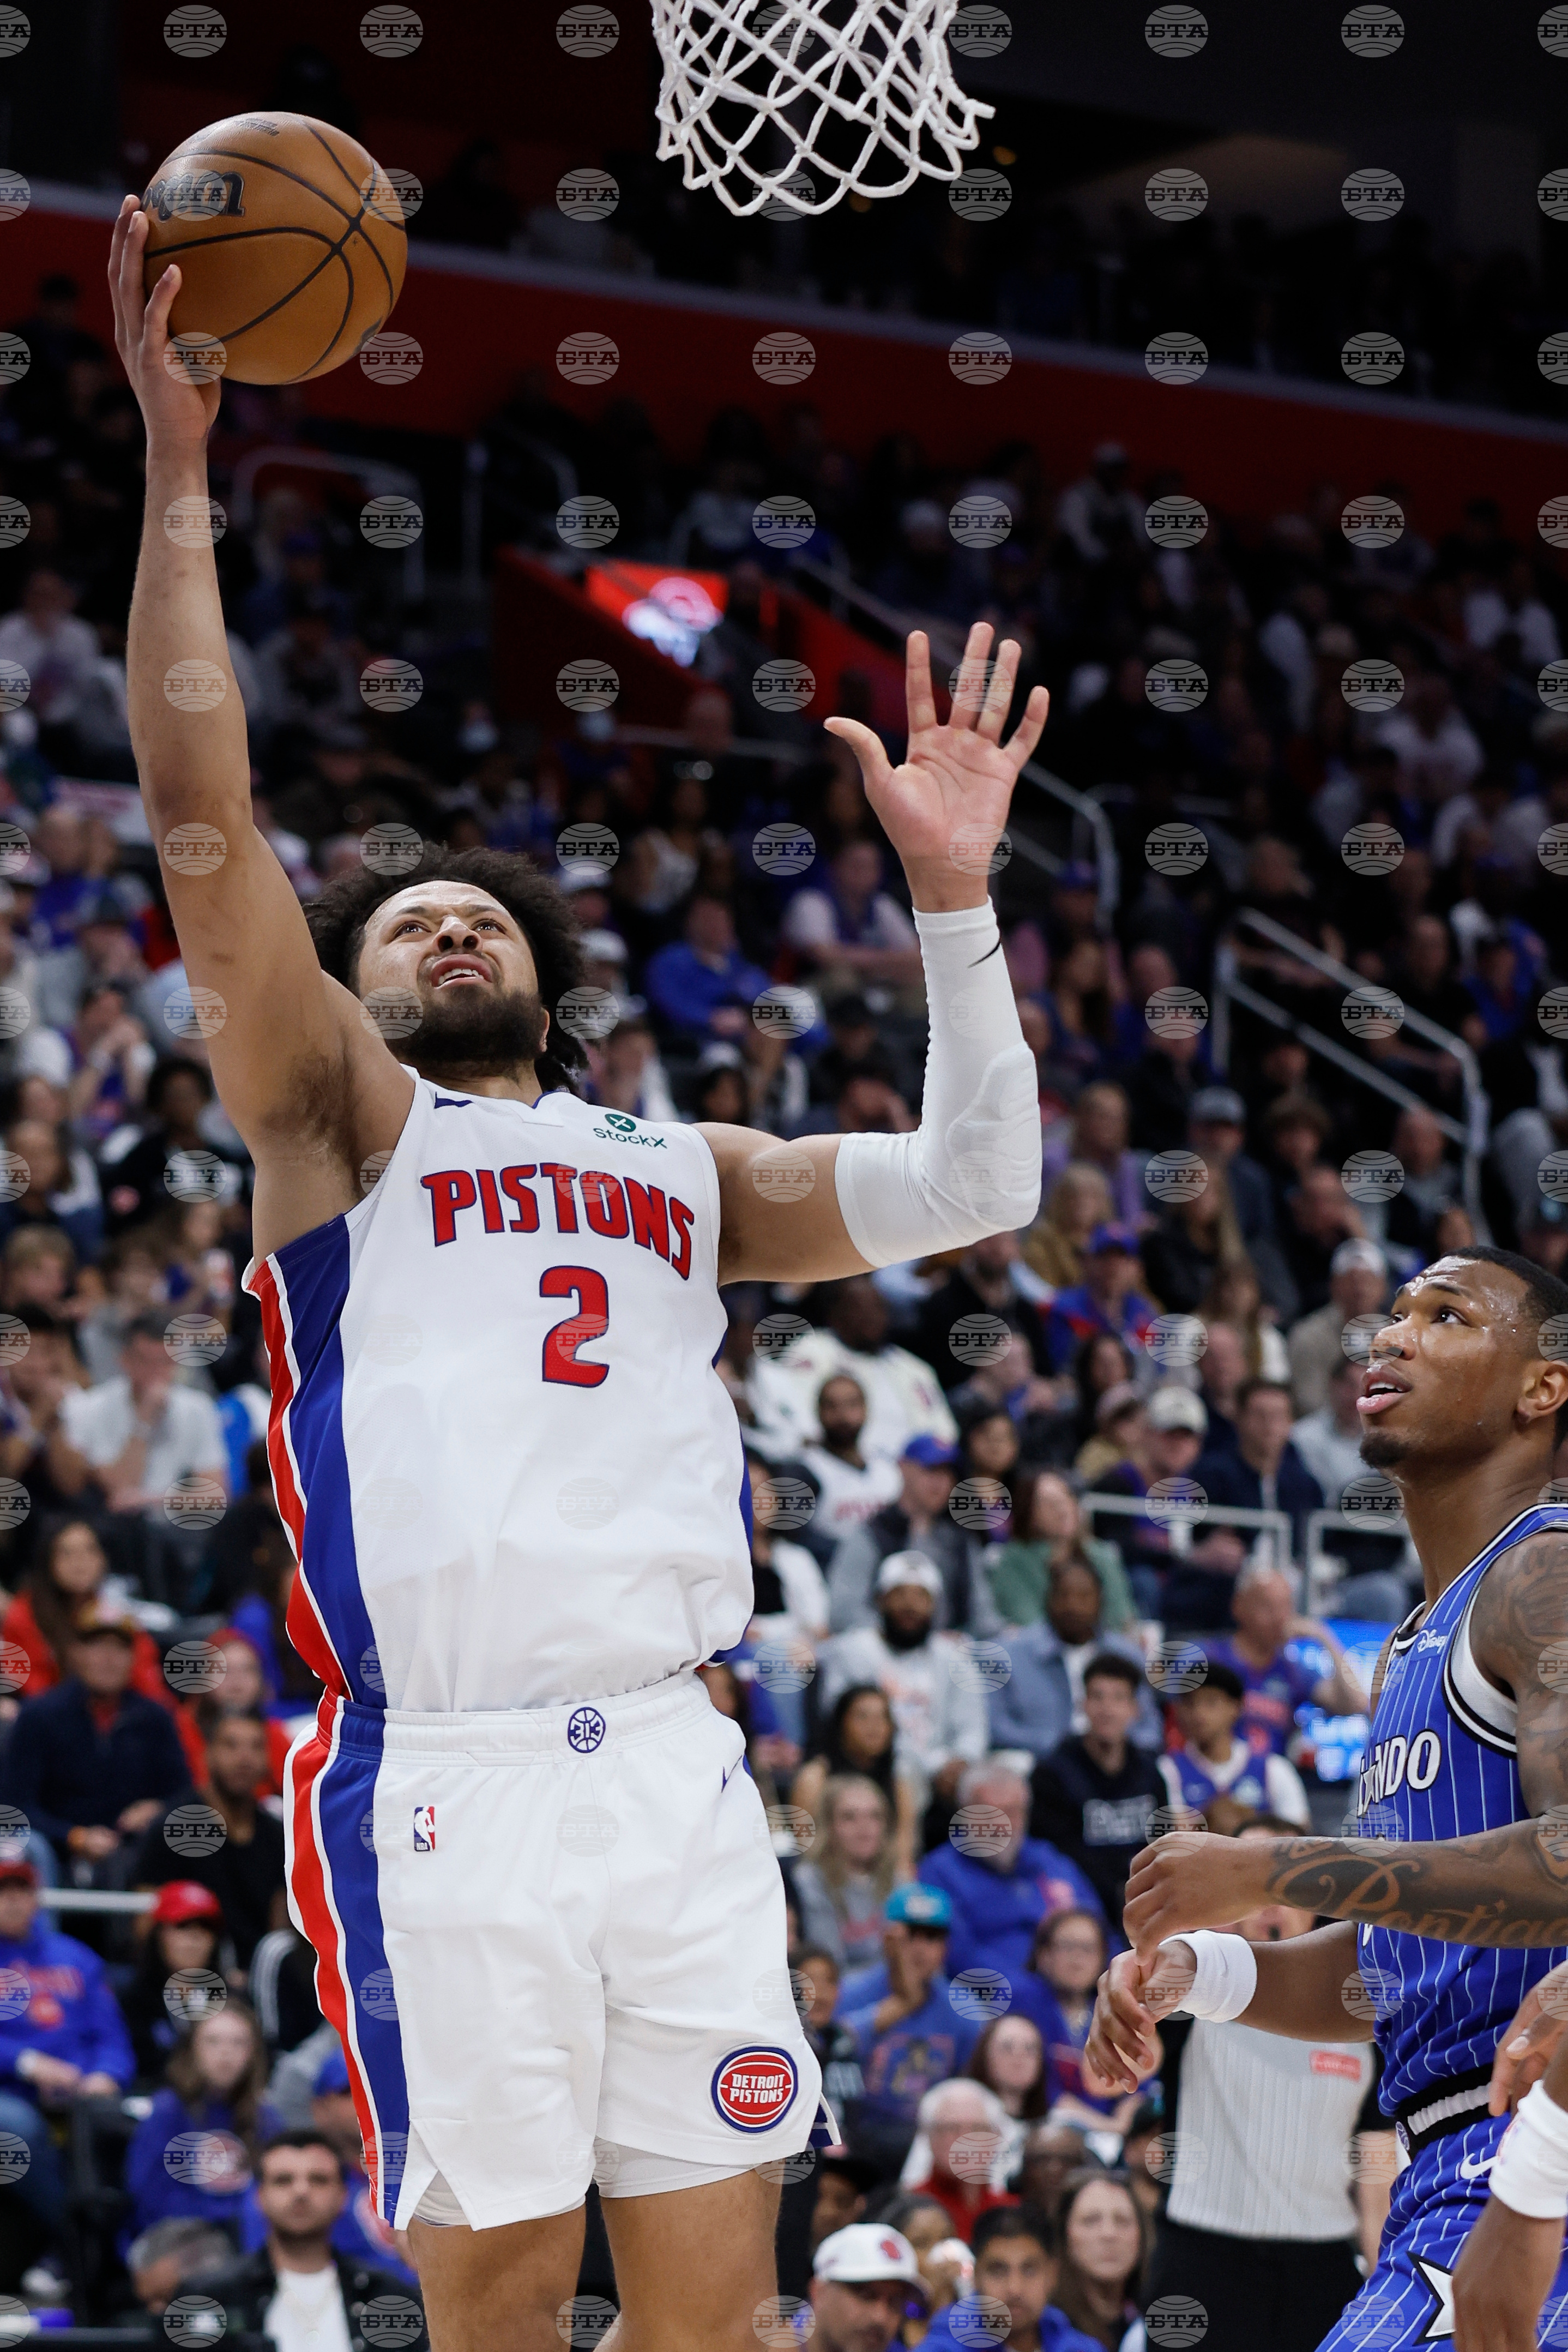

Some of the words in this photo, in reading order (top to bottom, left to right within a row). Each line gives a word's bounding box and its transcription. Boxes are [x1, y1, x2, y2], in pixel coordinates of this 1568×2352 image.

[420, 1162, 695, 1280] PISTONS
[539, 1265, 610, 1388] 2
[729, 2088, 784, 2104] PISTONS
[731, 2073, 785, 2089] DETROIT
